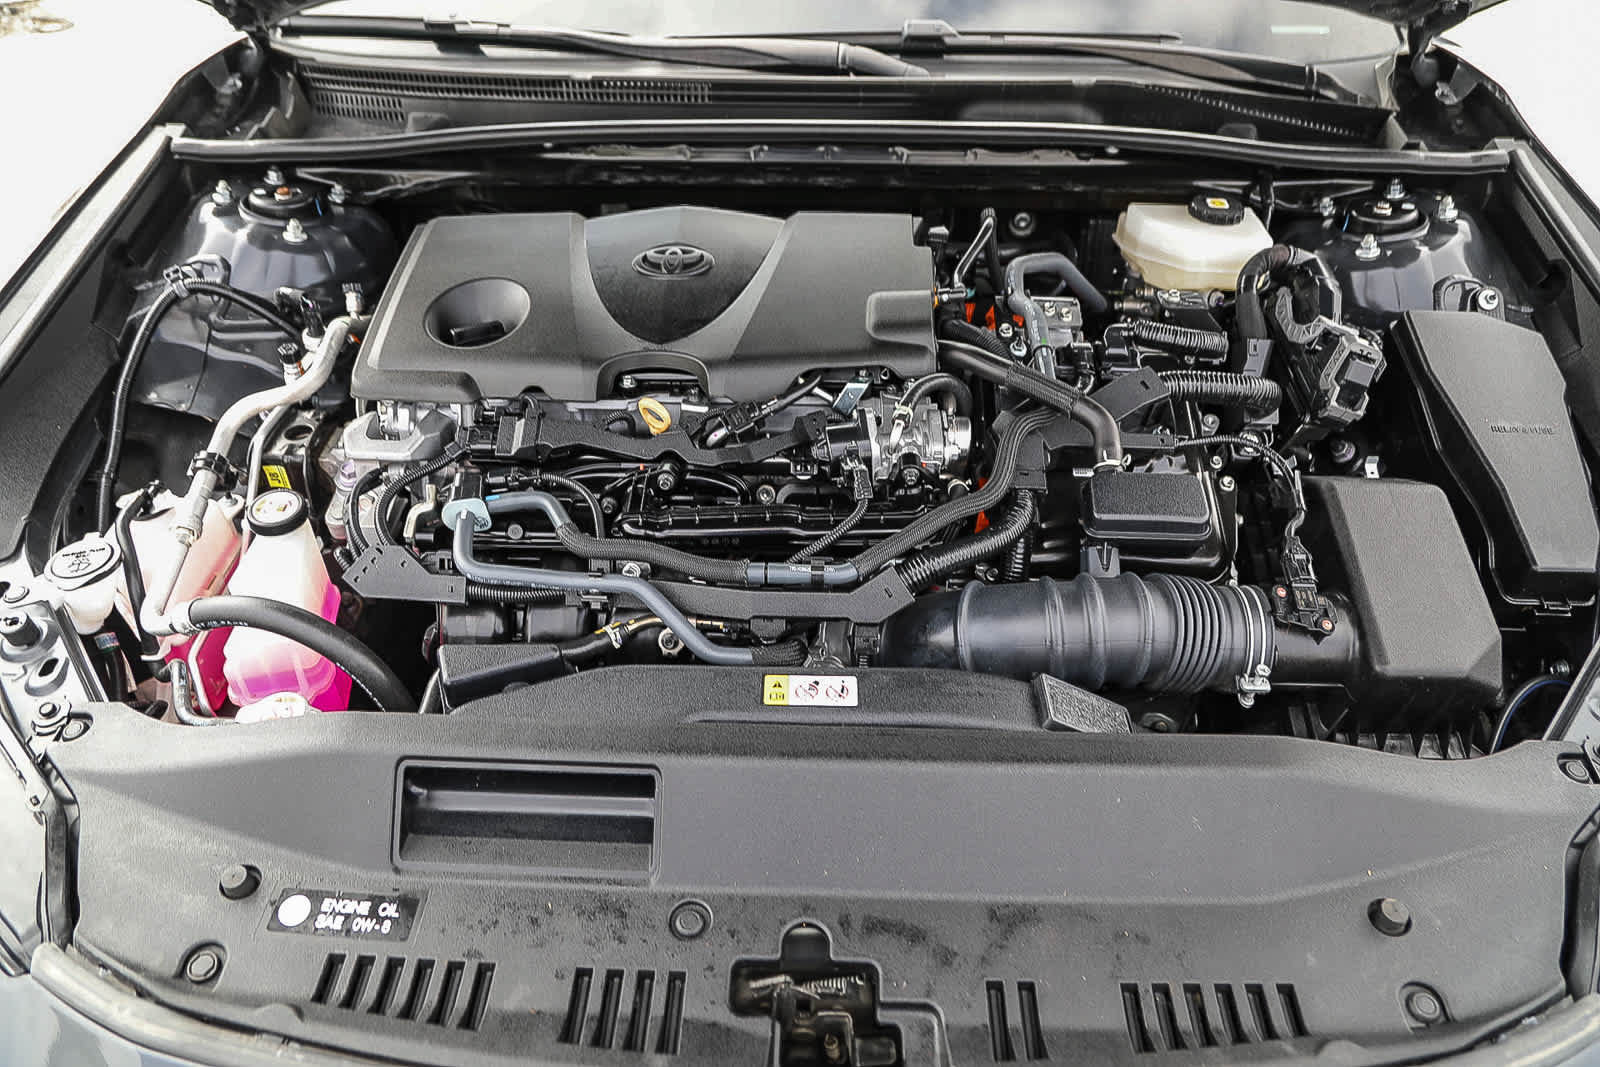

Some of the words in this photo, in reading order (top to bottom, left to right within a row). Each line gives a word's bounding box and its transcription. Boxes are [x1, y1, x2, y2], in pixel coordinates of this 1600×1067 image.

[320, 898, 371, 916] ENGINE
[377, 902, 400, 918] OIL
[314, 914, 345, 930] SAE
